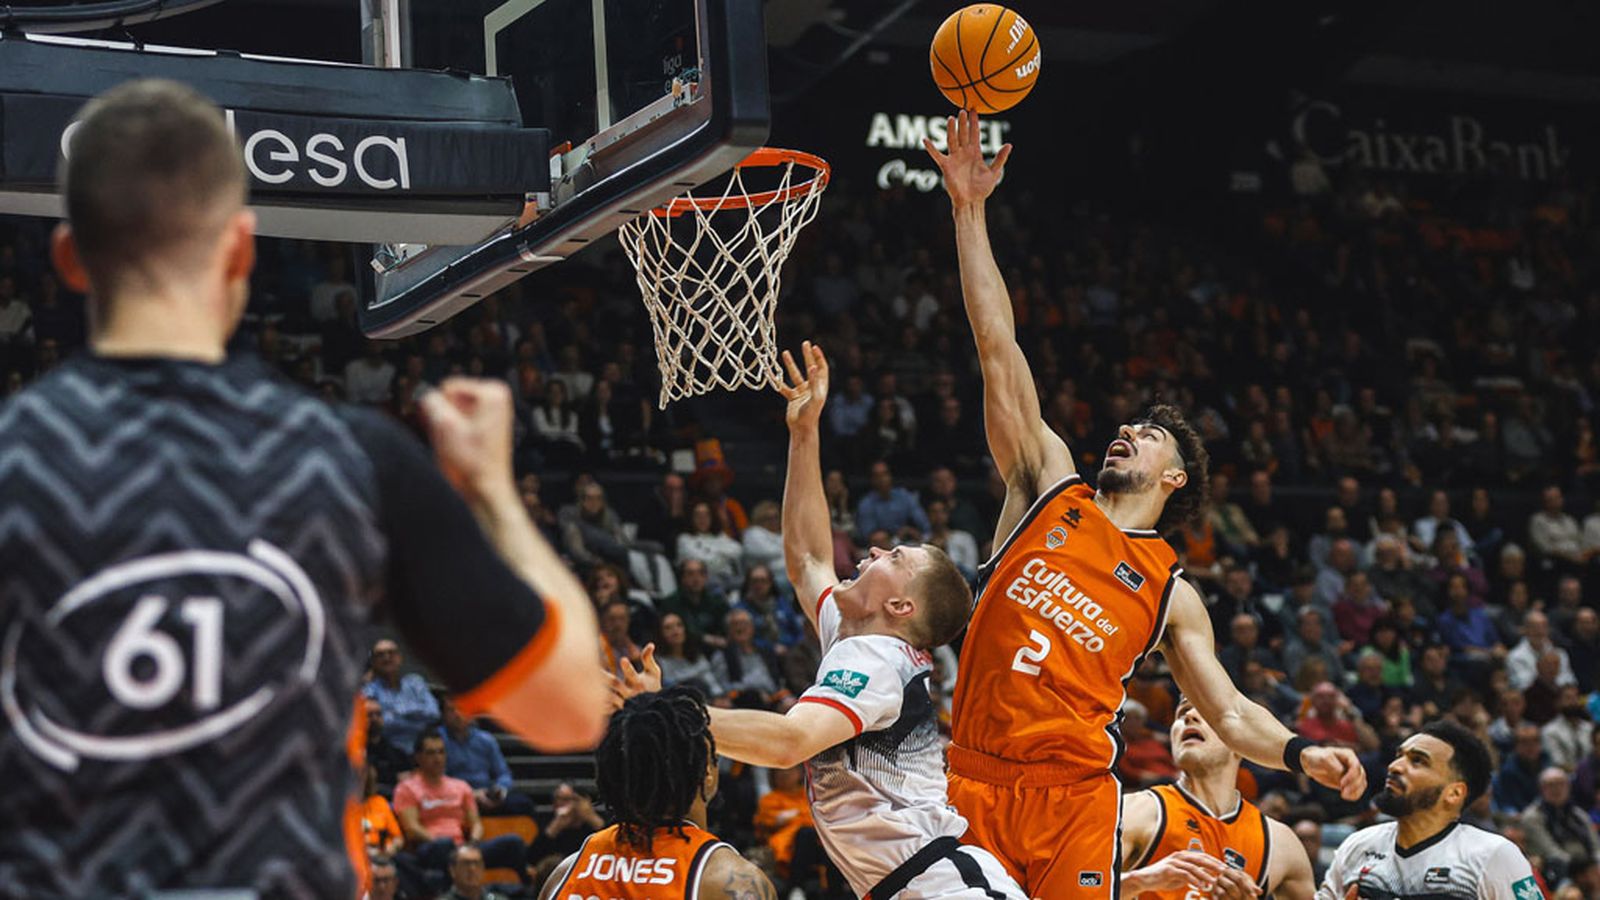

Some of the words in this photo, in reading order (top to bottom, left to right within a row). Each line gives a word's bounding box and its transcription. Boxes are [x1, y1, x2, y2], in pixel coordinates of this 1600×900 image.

[866, 112, 1004, 153] AMSEL
[1006, 577, 1105, 653] Esfuerzo
[1022, 558, 1104, 620] Cultura
[1096, 616, 1119, 637] del
[103, 596, 223, 711] 61
[1011, 629, 1051, 677] 2
[577, 853, 677, 885] JONES
